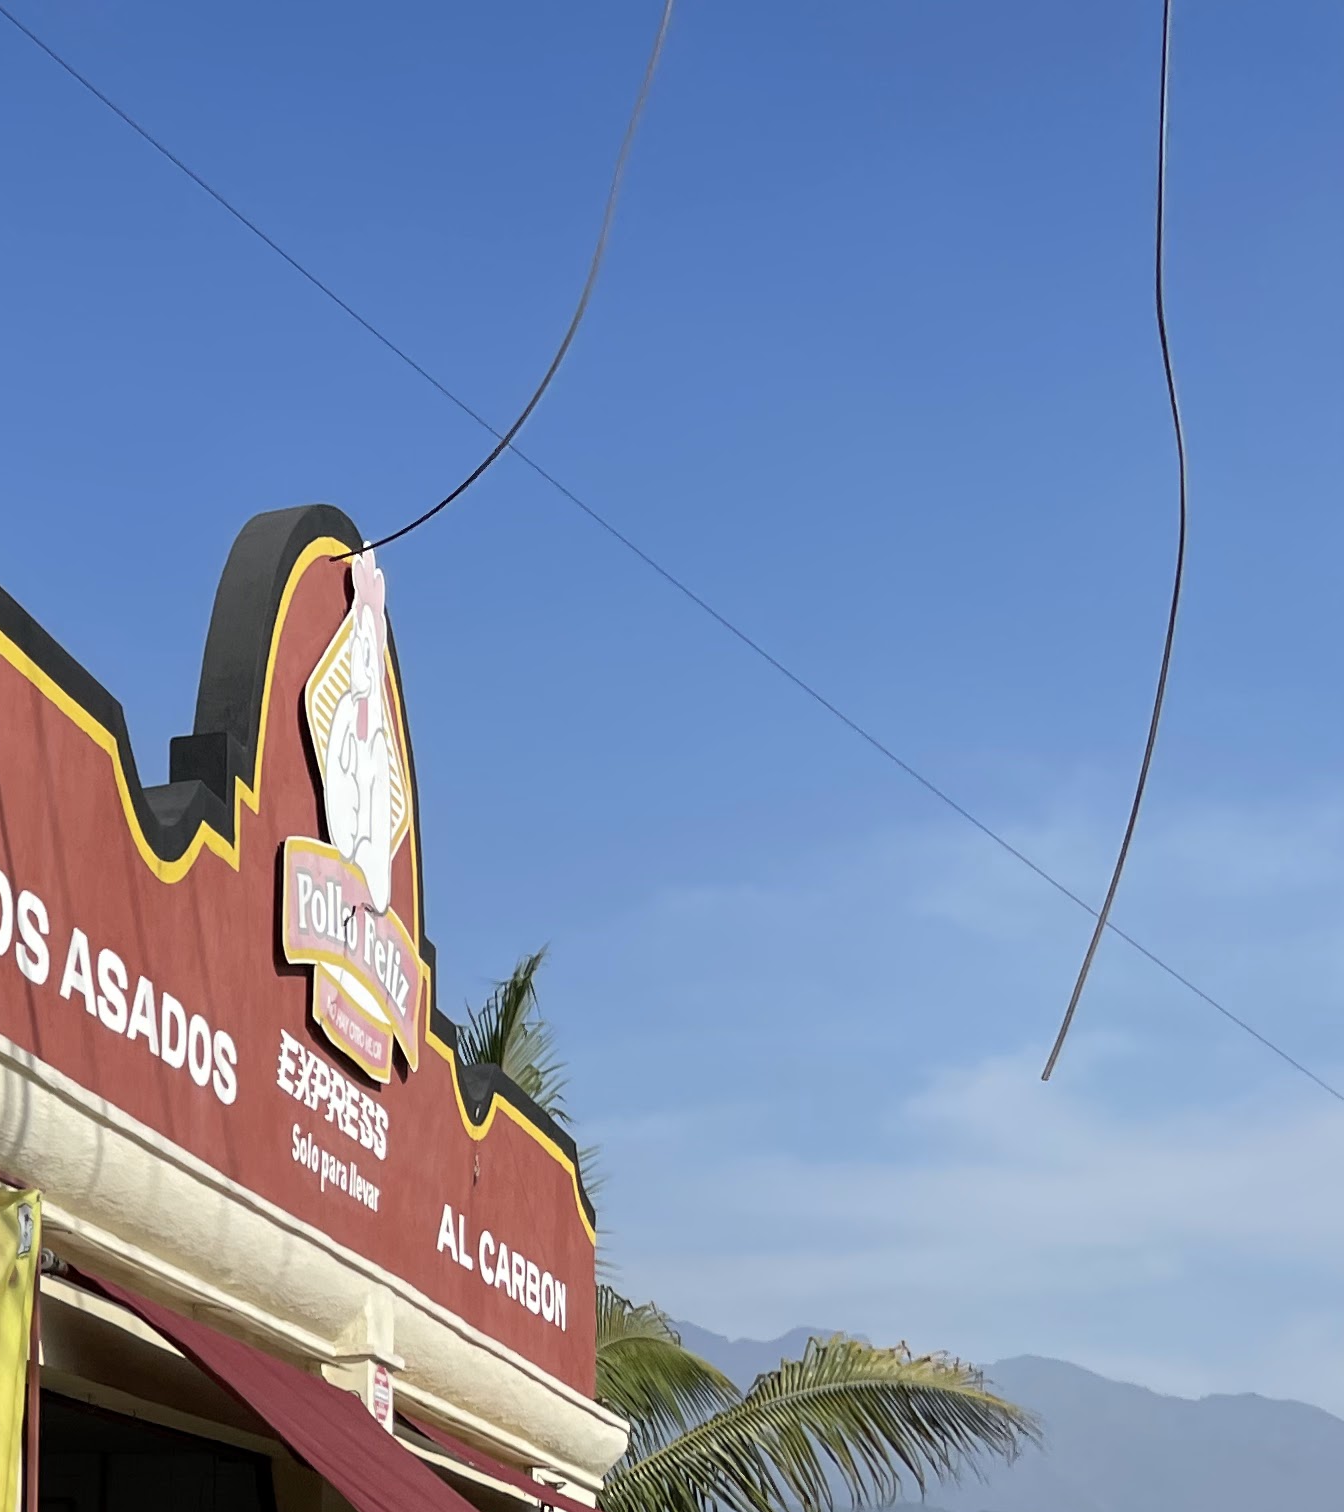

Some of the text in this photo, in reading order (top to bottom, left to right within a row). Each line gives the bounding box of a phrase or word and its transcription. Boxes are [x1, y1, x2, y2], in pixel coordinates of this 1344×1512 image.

[296, 872, 410, 1017] Pollo Feliz
[59, 927, 238, 1105] ASADOS
[276, 1028, 389, 1161] EXPRESS
[291, 1123, 380, 1213] Solo para llevar
[437, 1203, 566, 1332] AL CARBON
